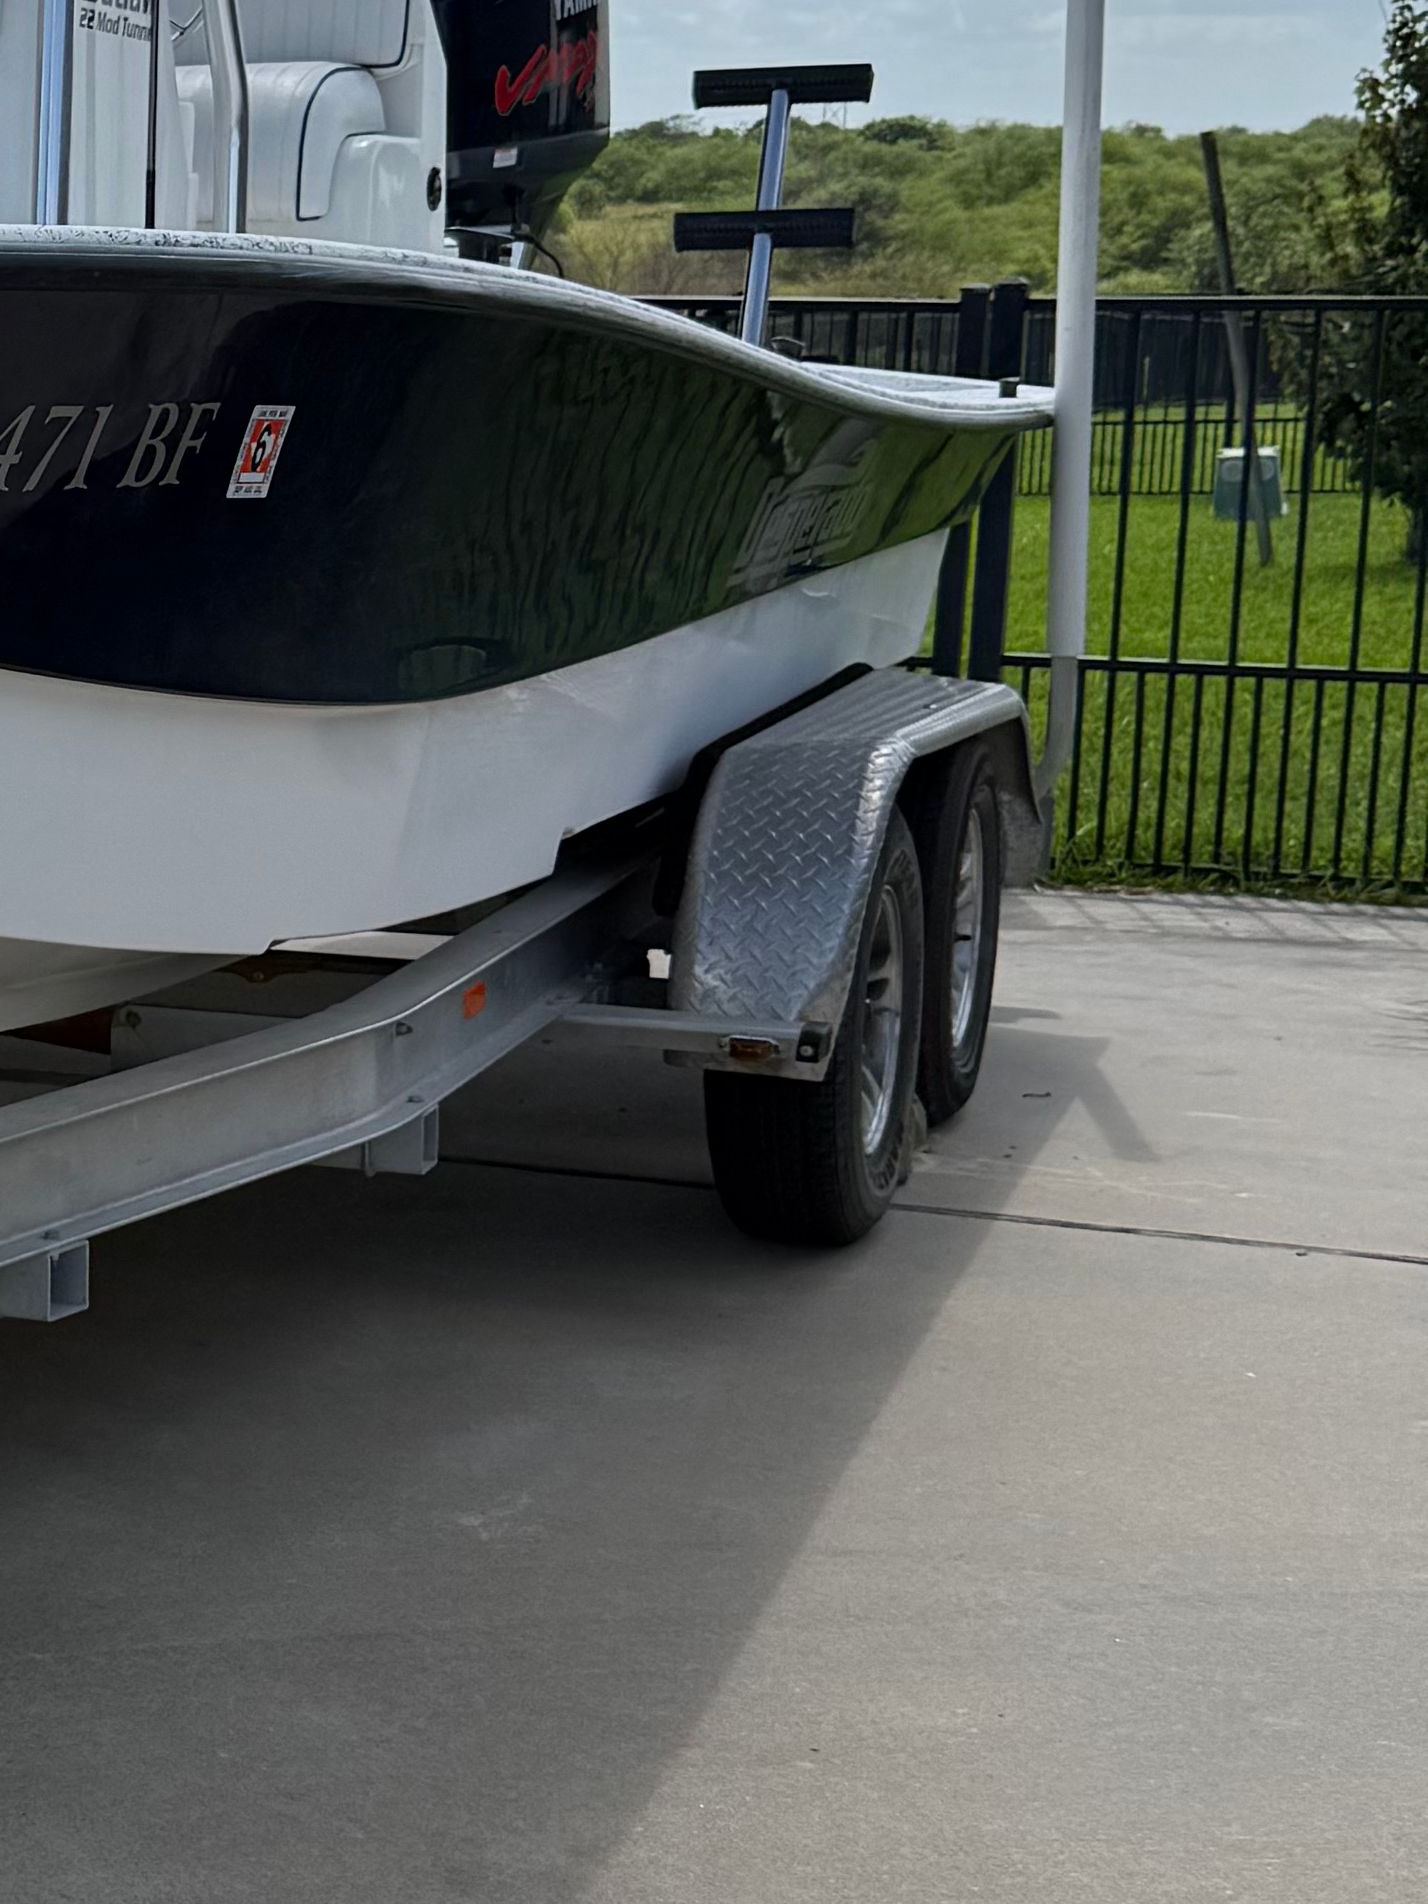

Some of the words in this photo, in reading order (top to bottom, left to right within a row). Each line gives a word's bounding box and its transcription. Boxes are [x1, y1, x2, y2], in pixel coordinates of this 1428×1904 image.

[79, 7, 96, 30] 22
[96, 11, 121, 35] Mod
[116, 402, 221, 489] BF
